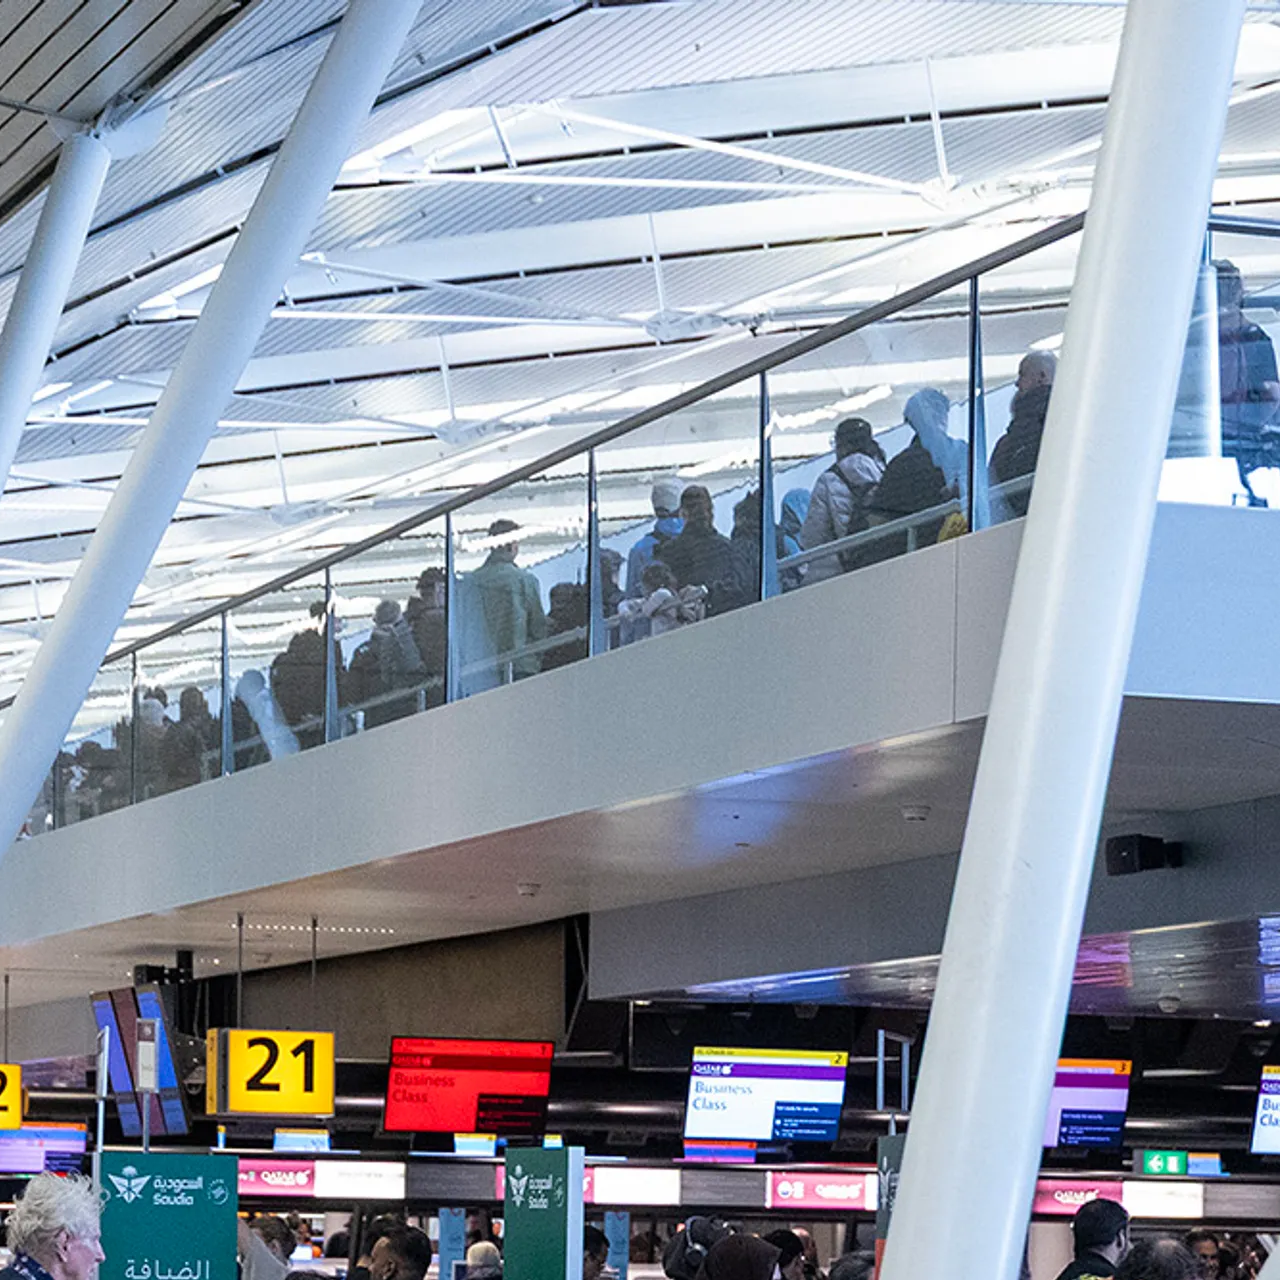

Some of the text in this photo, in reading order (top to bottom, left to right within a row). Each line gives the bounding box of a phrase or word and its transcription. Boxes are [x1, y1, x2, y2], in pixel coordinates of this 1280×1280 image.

[245, 1036, 316, 1093] 21
[834, 1054, 843, 1064] 2
[393, 1072, 456, 1087] Business
[694, 1081, 753, 1095] Business
[392, 1089, 429, 1103] Class
[692, 1098, 727, 1111] Class
